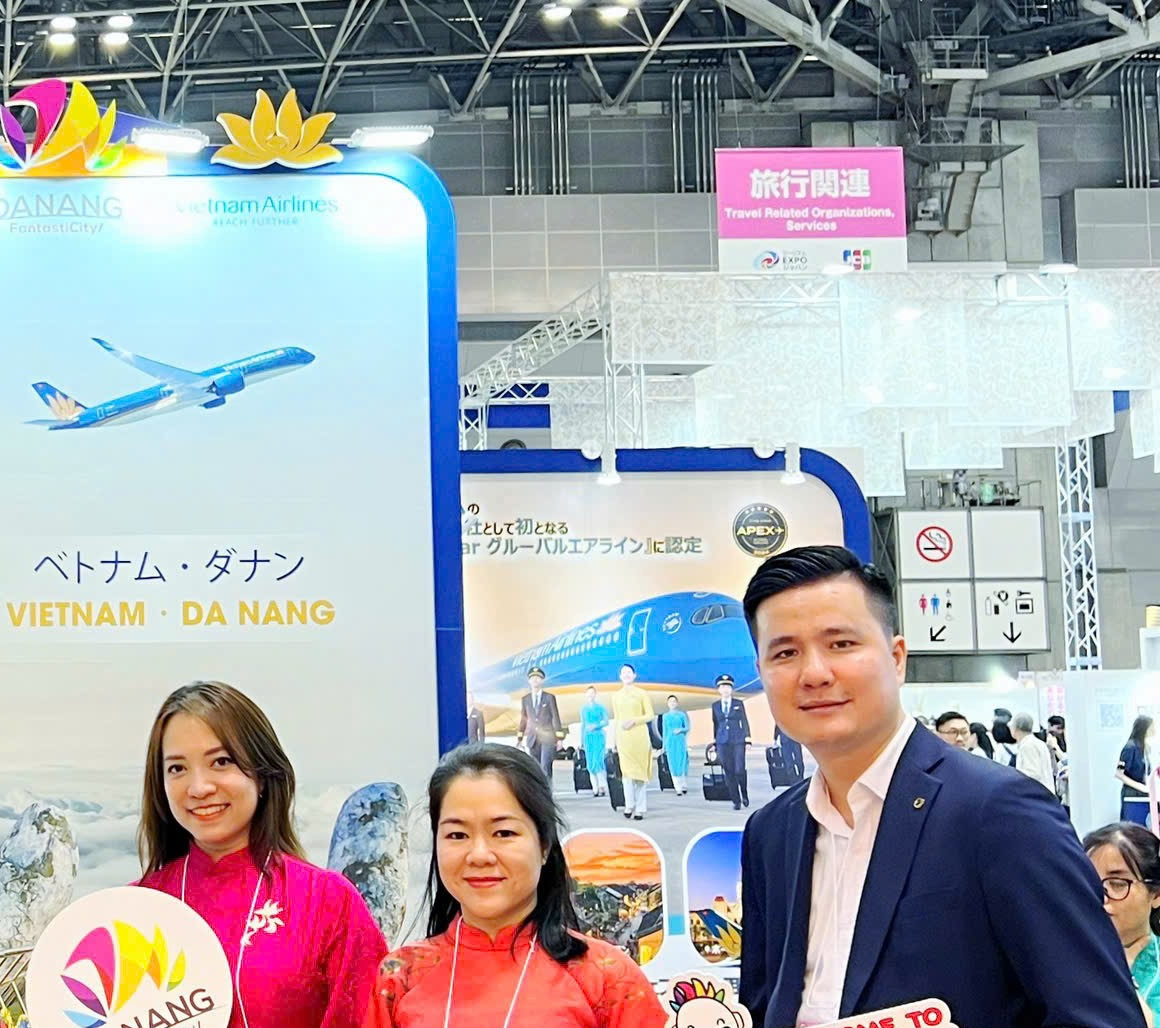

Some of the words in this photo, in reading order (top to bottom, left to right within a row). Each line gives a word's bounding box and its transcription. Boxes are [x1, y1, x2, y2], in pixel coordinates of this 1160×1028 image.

[749, 168, 870, 199] 旅行関連
[262, 194, 338, 213] Airlines
[724, 207, 762, 219] Travel
[765, 207, 808, 218] Related
[811, 207, 895, 220] Organizations,
[786, 220, 837, 232] Services
[782, 256, 808, 264] EXPO
[34, 548, 304, 584] ベトナム・ダナン
[6, 601, 145, 627] VIETNAM
[182, 601, 227, 626] DA
[239, 600, 336, 626] NANG
[905, 1007, 942, 1028] TO
